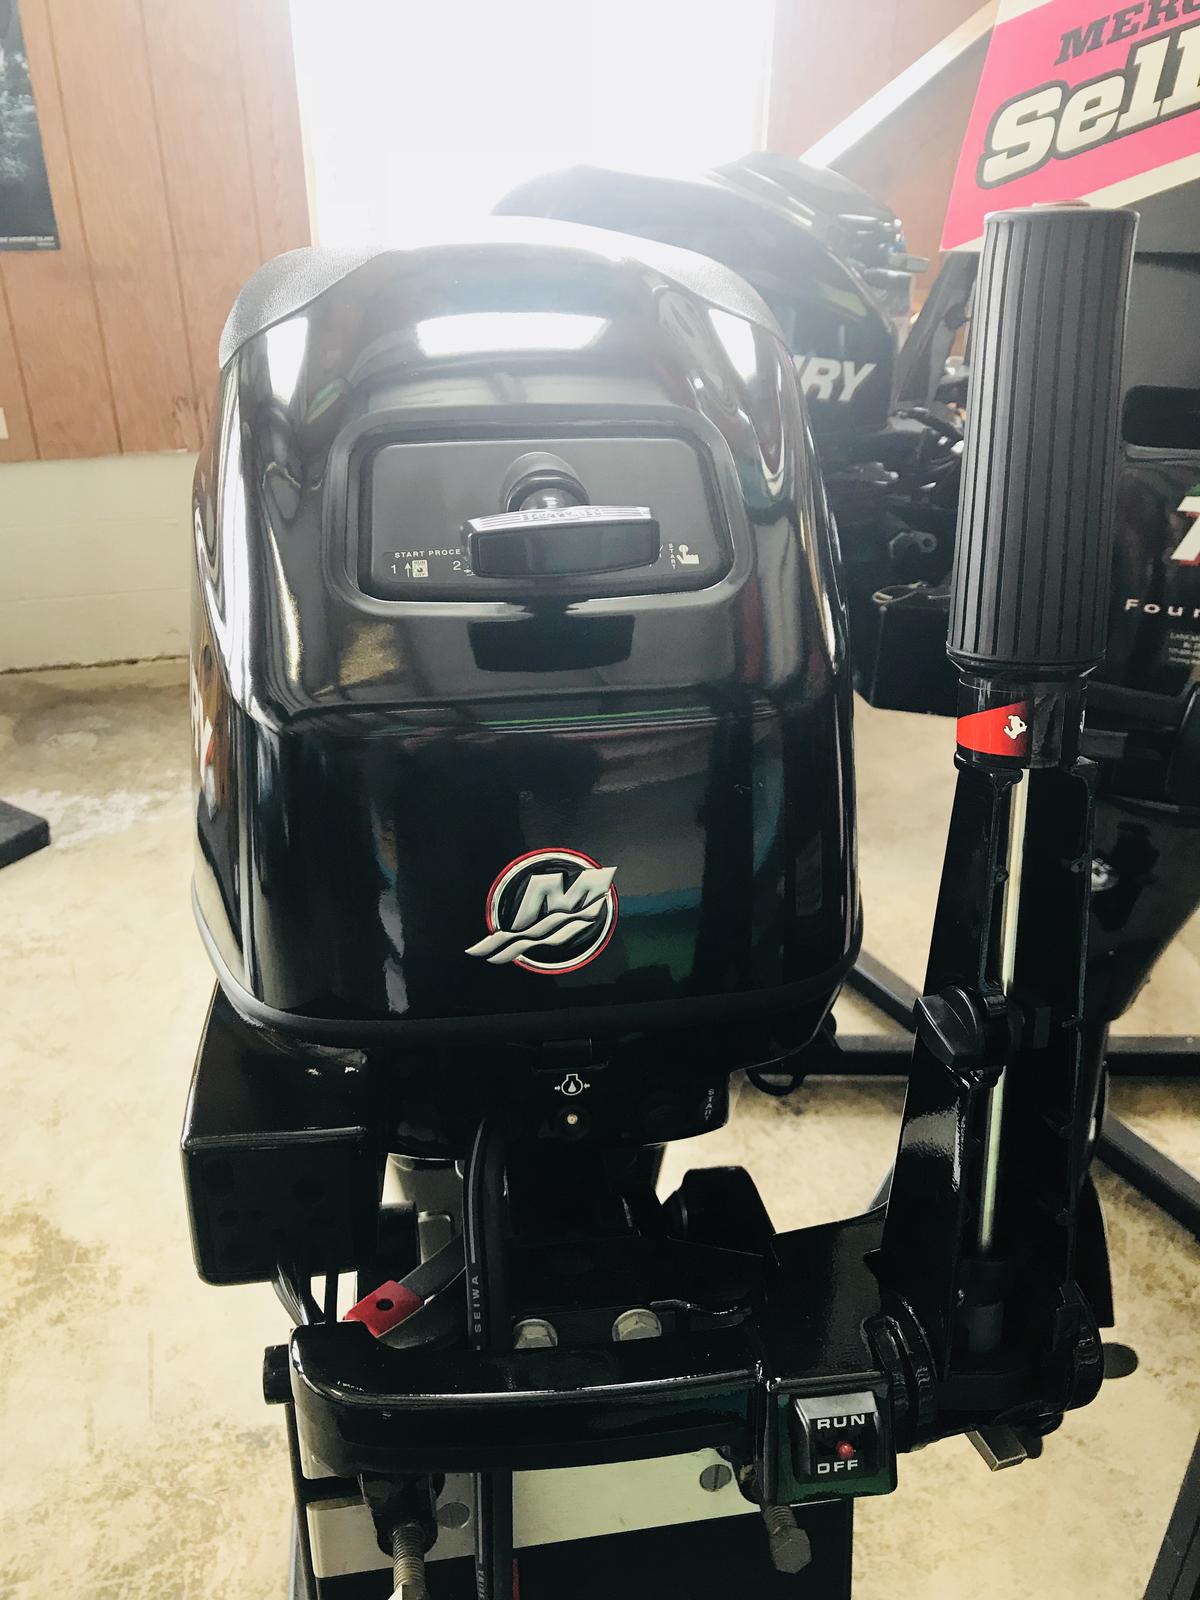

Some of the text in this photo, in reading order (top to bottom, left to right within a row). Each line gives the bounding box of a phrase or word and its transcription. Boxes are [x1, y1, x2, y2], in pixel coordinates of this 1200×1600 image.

[793, 354, 878, 402] RY
[394, 550, 425, 559] START
[390, 564, 397, 575] 1
[453, 560, 462, 571] 2
[471, 1275, 482, 1333] SEIWA
[817, 1414, 866, 1430] RUN
[817, 1459, 859, 1475] OFF
